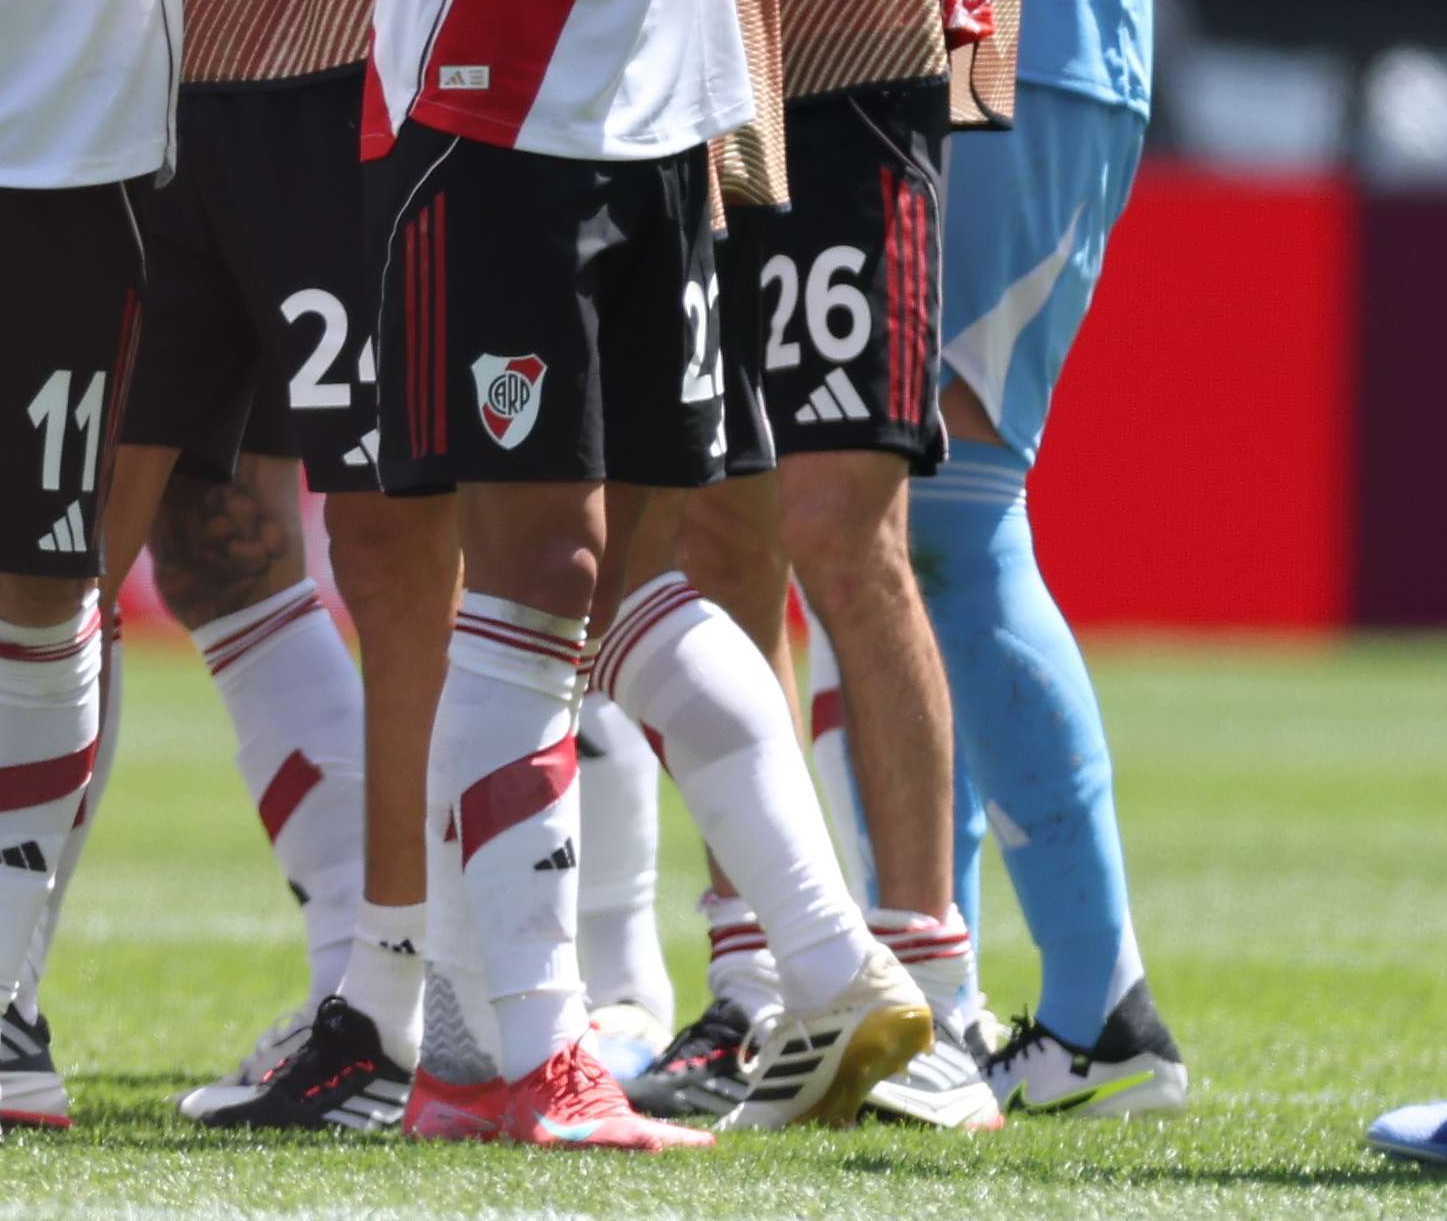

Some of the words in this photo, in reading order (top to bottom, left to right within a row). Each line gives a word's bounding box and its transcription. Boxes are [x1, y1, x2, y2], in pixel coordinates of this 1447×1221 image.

[758, 244, 873, 370] 26
[26, 370, 107, 492] 11
[488, 373, 531, 416] CARP
